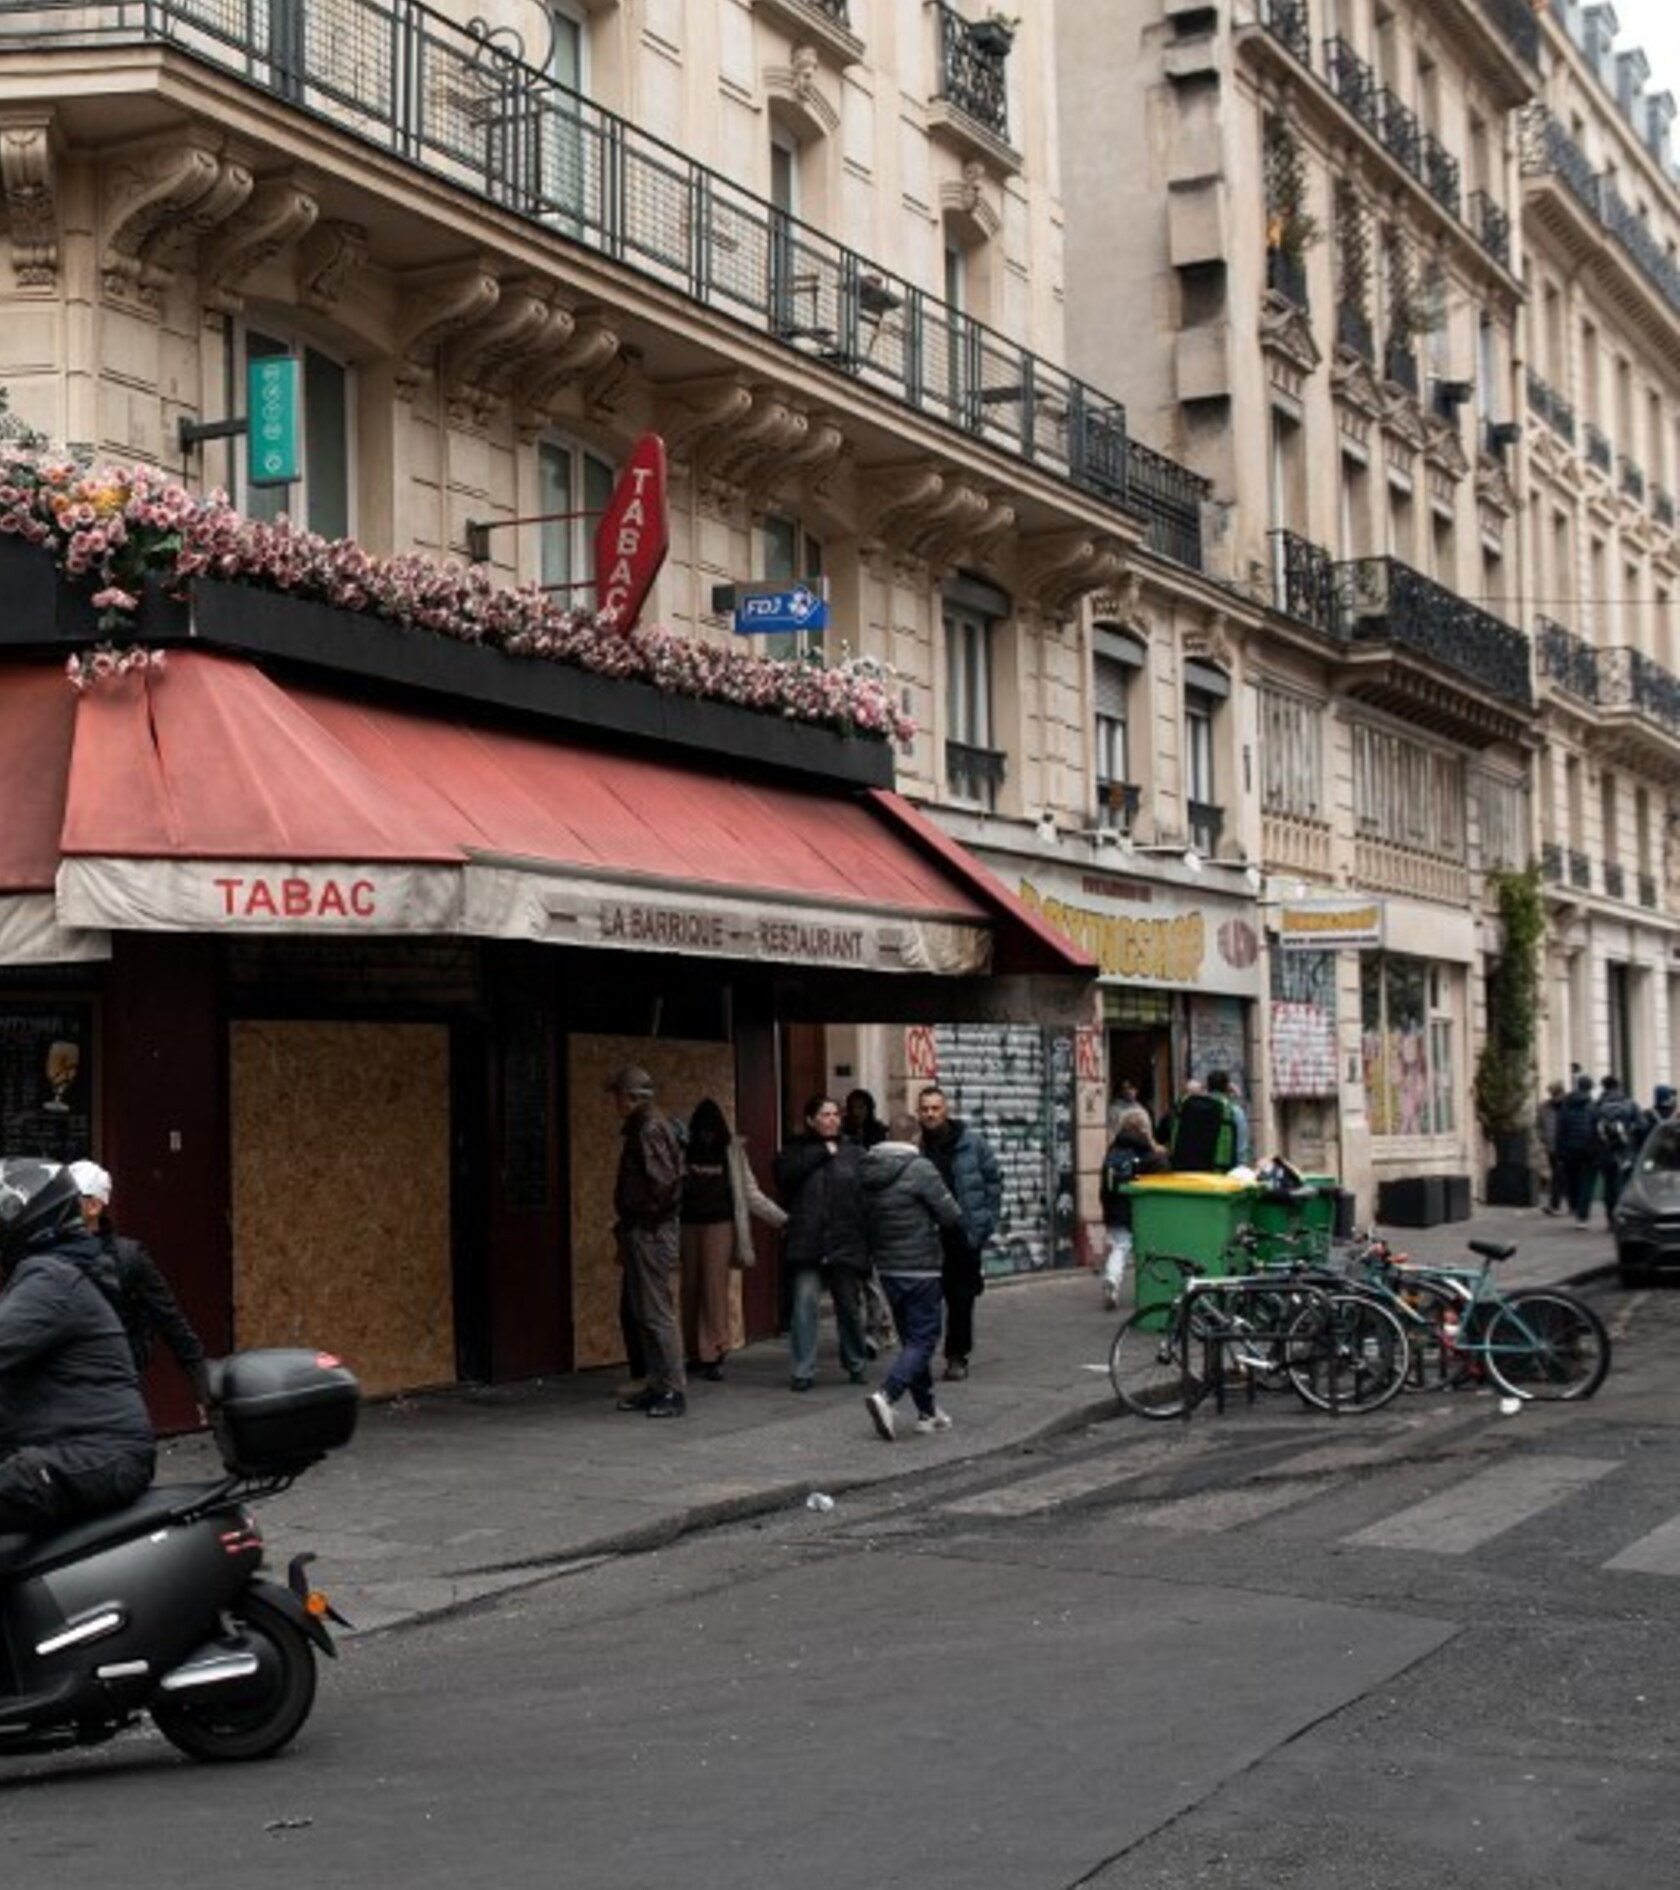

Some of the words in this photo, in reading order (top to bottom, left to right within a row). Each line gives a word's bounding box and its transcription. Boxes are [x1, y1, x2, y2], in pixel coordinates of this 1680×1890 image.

[747, 597, 782, 615] FDJ
[213, 878, 376, 917] TABAC
[599, 902, 625, 937] LA
[630, 906, 723, 948] BARRIQUE
[759, 920, 866, 960] RESTAURANT
